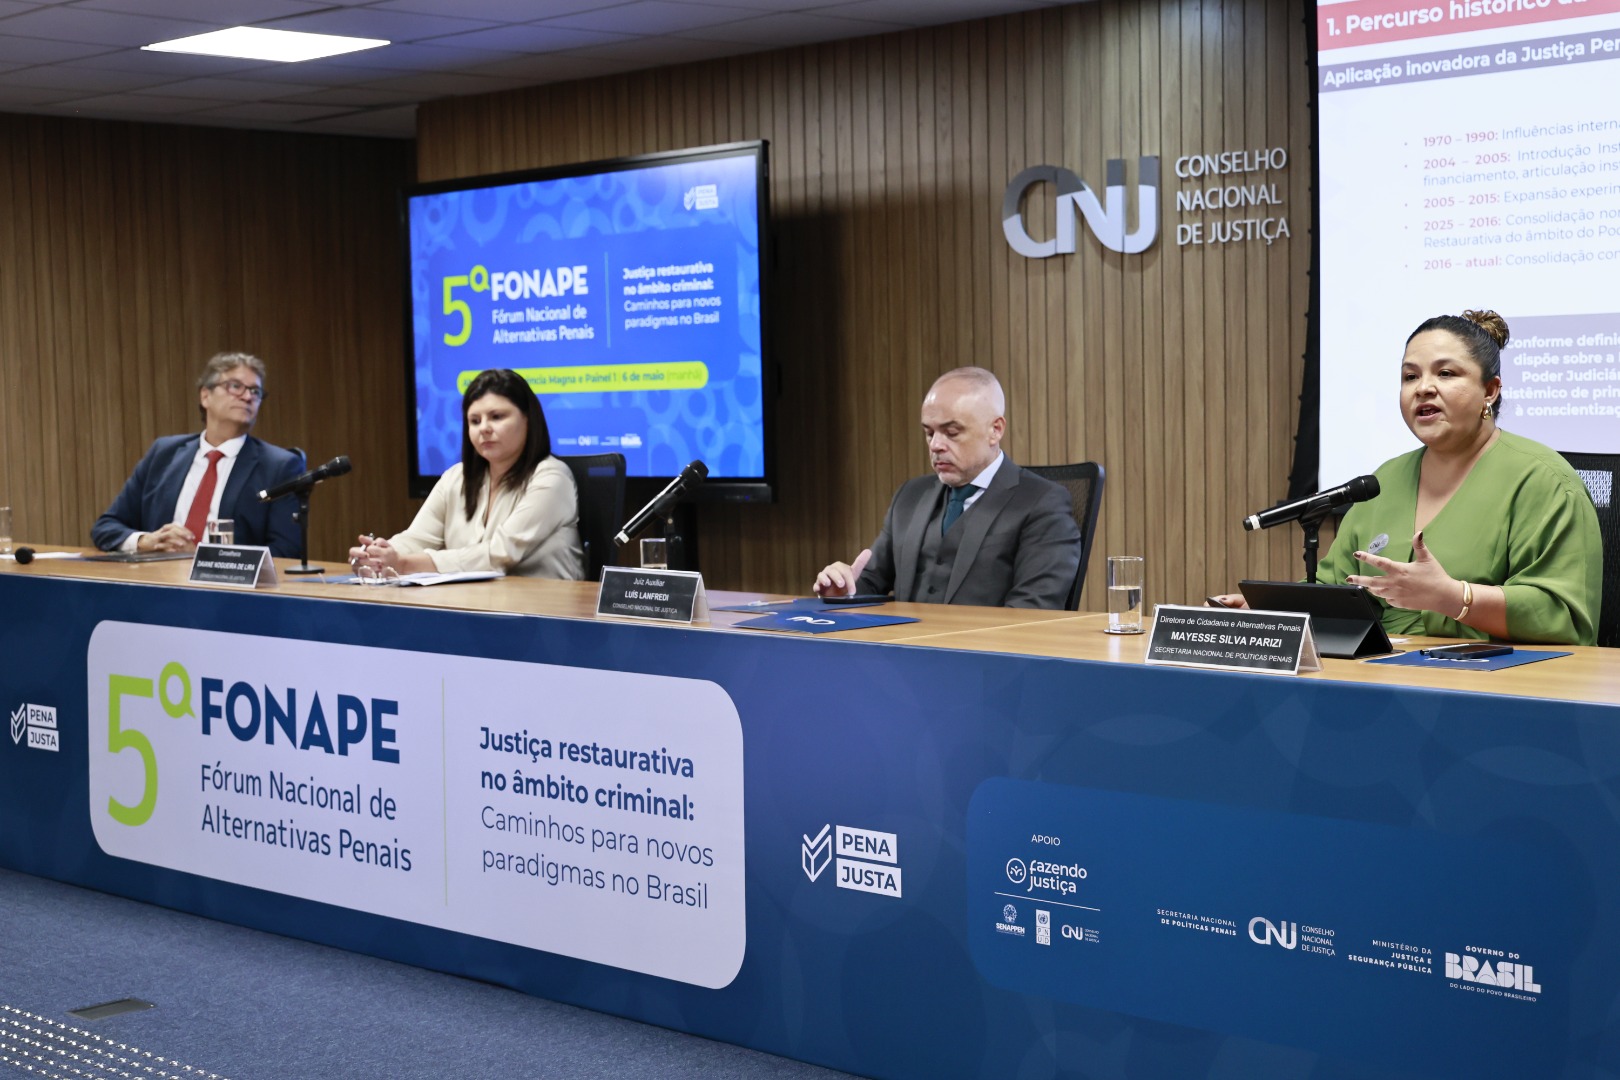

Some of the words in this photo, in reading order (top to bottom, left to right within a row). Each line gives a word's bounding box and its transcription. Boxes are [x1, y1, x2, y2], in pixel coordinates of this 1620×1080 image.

[1326, 18, 1340, 36] 1.
[1346, 6, 1443, 34] Percurso
[1323, 63, 1402, 87] Aplicação
[1406, 53, 1490, 76] inovadora
[1495, 49, 1517, 65] da
[1521, 41, 1585, 61] Justiça
[1424, 135, 1452, 147] 1970
[1466, 131, 1499, 143] 1990:
[1502, 121, 1574, 140] Influências
[1577, 120, 1620, 132] intern
[1175, 147, 1287, 178] CONSELHO
[1424, 157, 1456, 170] 2004
[1475, 152, 1511, 165] 2005:
[1517, 144, 1591, 161] Introdução
[1423, 171, 1519, 187] financiamento,
[1522, 162, 1596, 179] articulação
[1599, 160, 1620, 172] ins
[1002, 156, 1159, 258] CNJ
[1176, 183, 1282, 212] NACIONAL
[1424, 197, 1455, 209] 2005
[1468, 193, 1500, 206] 2015:
[1504, 187, 1568, 204] Expansão
[1424, 219, 1454, 231] 2025
[1469, 216, 1501, 229] 2016:
[1505, 209, 1595, 227] Consolidação
[1177, 223, 1203, 246] DE
[1208, 217, 1290, 245] JUSTIÇA
[1424, 233, 1502, 248] Restaurativa
[1505, 229, 1523, 243] do
[1525, 226, 1573, 242] âmbito
[1577, 226, 1594, 238] do
[1424, 259, 1452, 270] 2016
[1465, 255, 1502, 268] atual:
[1505, 249, 1594, 266] Consolidação
[491, 265, 589, 301] FONAPE
[492, 308, 525, 324] Fórum
[525, 304, 571, 322] Nacional
[572, 304, 588, 319] de
[492, 327, 557, 344] Alternativas
[559, 324, 594, 340] Penais
[1513, 352, 1559, 367] dispõe
[1563, 351, 1602, 364] sobre
[1606, 354, 1615, 363] a
[1522, 370, 1563, 382] Poder
[1571, 386, 1589, 398] de
[1515, 404, 1524, 417] à
[633, 578, 645, 586] Juiz
[645, 579, 666, 587] Auxiliar
[625, 590, 638, 599] LUÍS
[639, 591, 669, 602] LANFREDI
[1160, 615, 1185, 625] Diretora
[1196, 618, 1229, 628] Cidadania
[1236, 620, 1276, 631] Alternativas
[1277, 623, 1301, 632] Penais
[1171, 631, 1218, 644] MAYESSE
[1219, 635, 1247, 646] SILVA
[1249, 637, 1282, 648] PARIZI
[1155, 646, 1192, 655] SECRETARIA
[1193, 649, 1224, 658] NACIONAL
[1235, 651, 1268, 661] POLÍTICAS
[1268, 654, 1293, 663] PENAIS
[30, 709, 54, 723] PENA
[201, 677, 400, 764] FONAPE
[30, 731, 57, 747] JUSTA
[479, 726, 552, 763] Justiça
[559, 741, 695, 778] restaurativa
[201, 761, 262, 797] Fórum
[270, 770, 361, 815] Nacional
[369, 787, 397, 821] de
[481, 770, 507, 791] no
[512, 769, 588, 804] âmbito
[594, 782, 695, 821] criminal:
[201, 803, 331, 856] Alternativas
[339, 829, 412, 872] Penais
[481, 805, 585, 845] Caminhos
[591, 827, 639, 854] para
[647, 836, 714, 867] novos
[842, 832, 891, 857] PENA
[1031, 834, 1061, 846] APOIO
[482, 849, 605, 889] paradigmas
[612, 873, 639, 895] no
[647, 874, 708, 909] Brasil
[841, 865, 897, 892] JUSTA
[1029, 859, 1088, 879] fazendo
[1027, 875, 1077, 896] justiça
[1157, 908, 1199, 921] SECRETARIA
[1200, 916, 1237, 927] NACIONAL
[1061, 924, 1083, 940] CNJ
[1172, 920, 1209, 932] POLÍTICAS
[1211, 926, 1237, 936] PENAIS
[1248, 916, 1297, 950] CNJ
[1301, 925, 1335, 937] CONSELHO
[1301, 935, 1334, 946] NACIONAL
[1301, 944, 1310, 952] DE
[1311, 946, 1336, 957] JUSTIÇA
[1372, 939, 1419, 953] MINISTÉRIO
[1421, 947, 1432, 955] DA
[1391, 952, 1424, 964] JUSTIÇA
[1465, 945, 1504, 957] GOVERNO
[1508, 952, 1520, 960] DO
[1348, 954, 1395, 968] SEGURANÇA
[1397, 961, 1432, 974] PÚBLICA
[1445, 952, 1542, 994] BRASIL
[1459, 984, 1475, 992] LADO
[1477, 986, 1486, 994] DO
[1487, 988, 1502, 997] POVO
[1504, 992, 1537, 1002] BRASILEIRO
